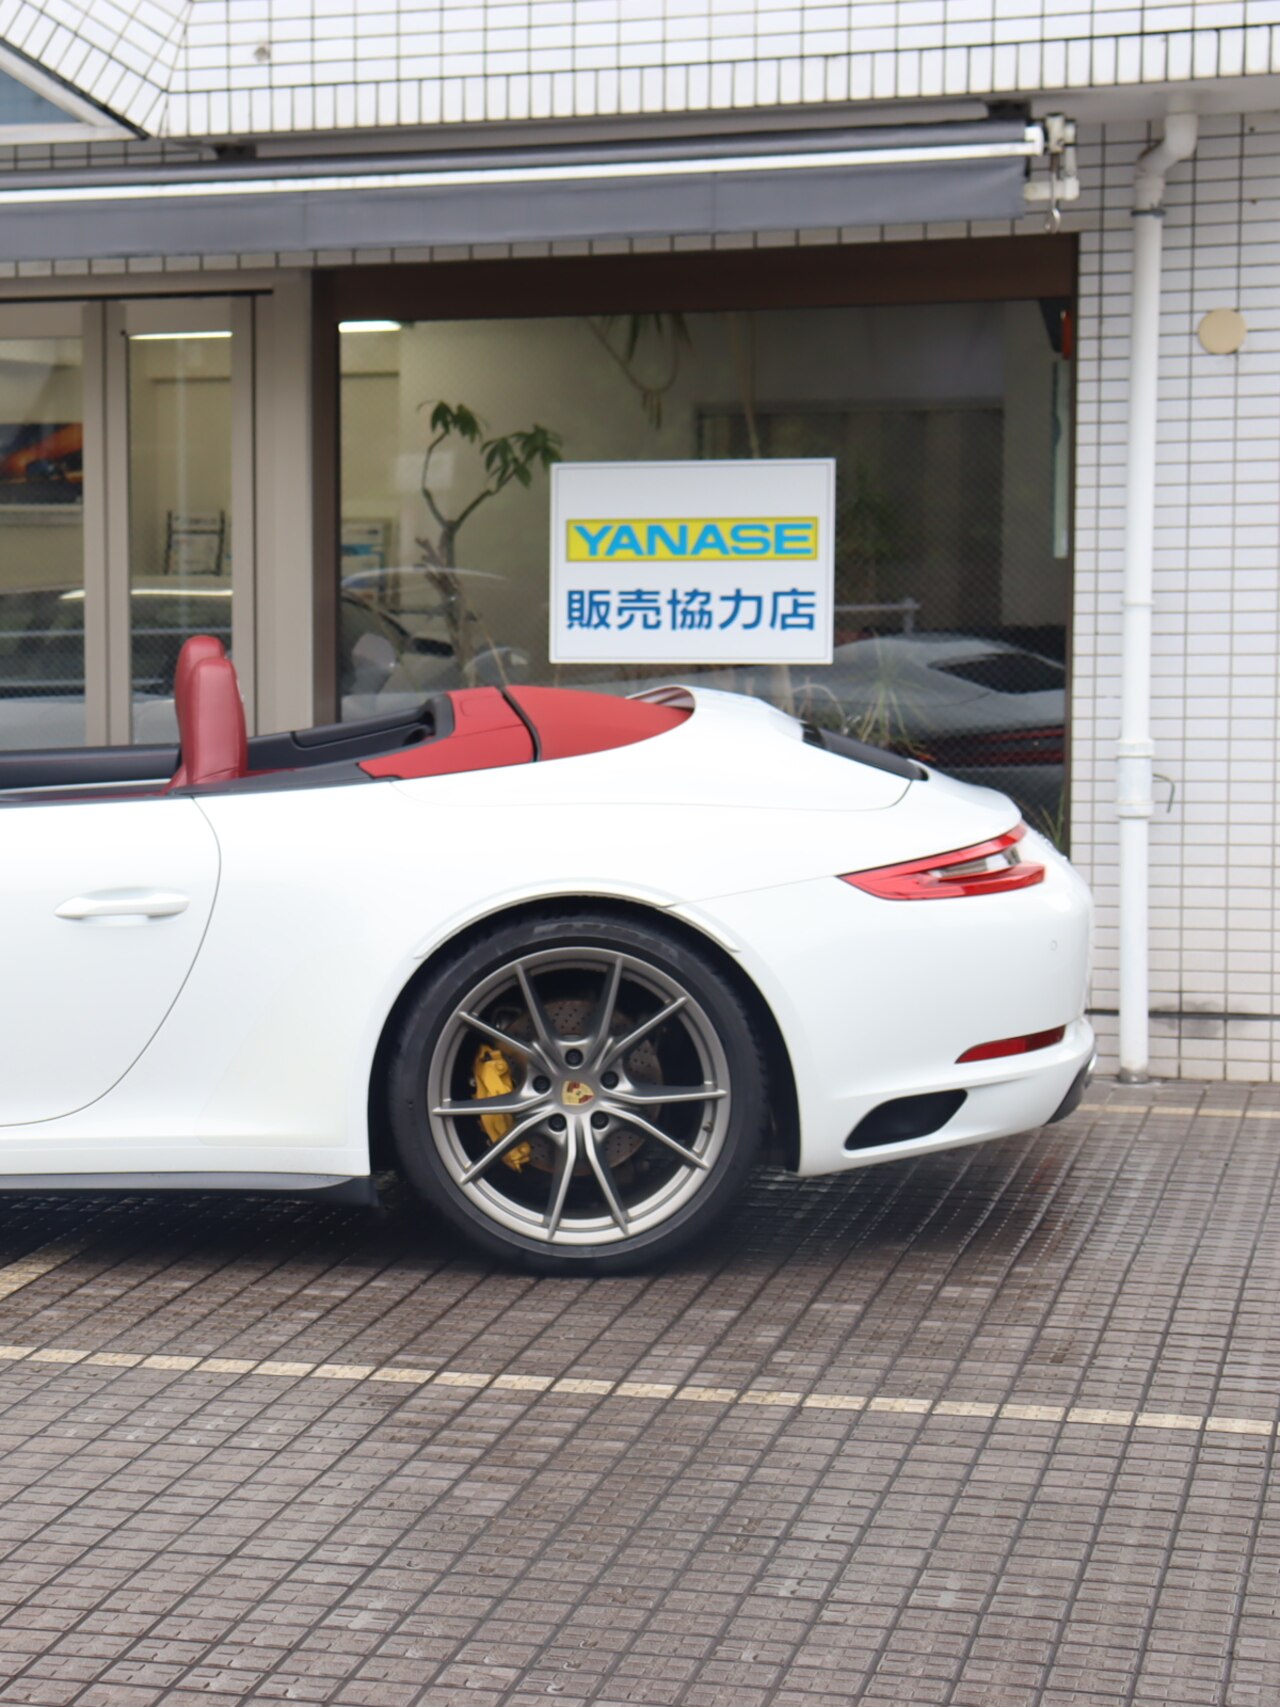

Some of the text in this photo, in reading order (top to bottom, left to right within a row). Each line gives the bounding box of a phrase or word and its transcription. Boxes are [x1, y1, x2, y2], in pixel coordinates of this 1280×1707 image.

[573, 523, 814, 557] YANASE
[566, 588, 817, 631] 販売協力店
